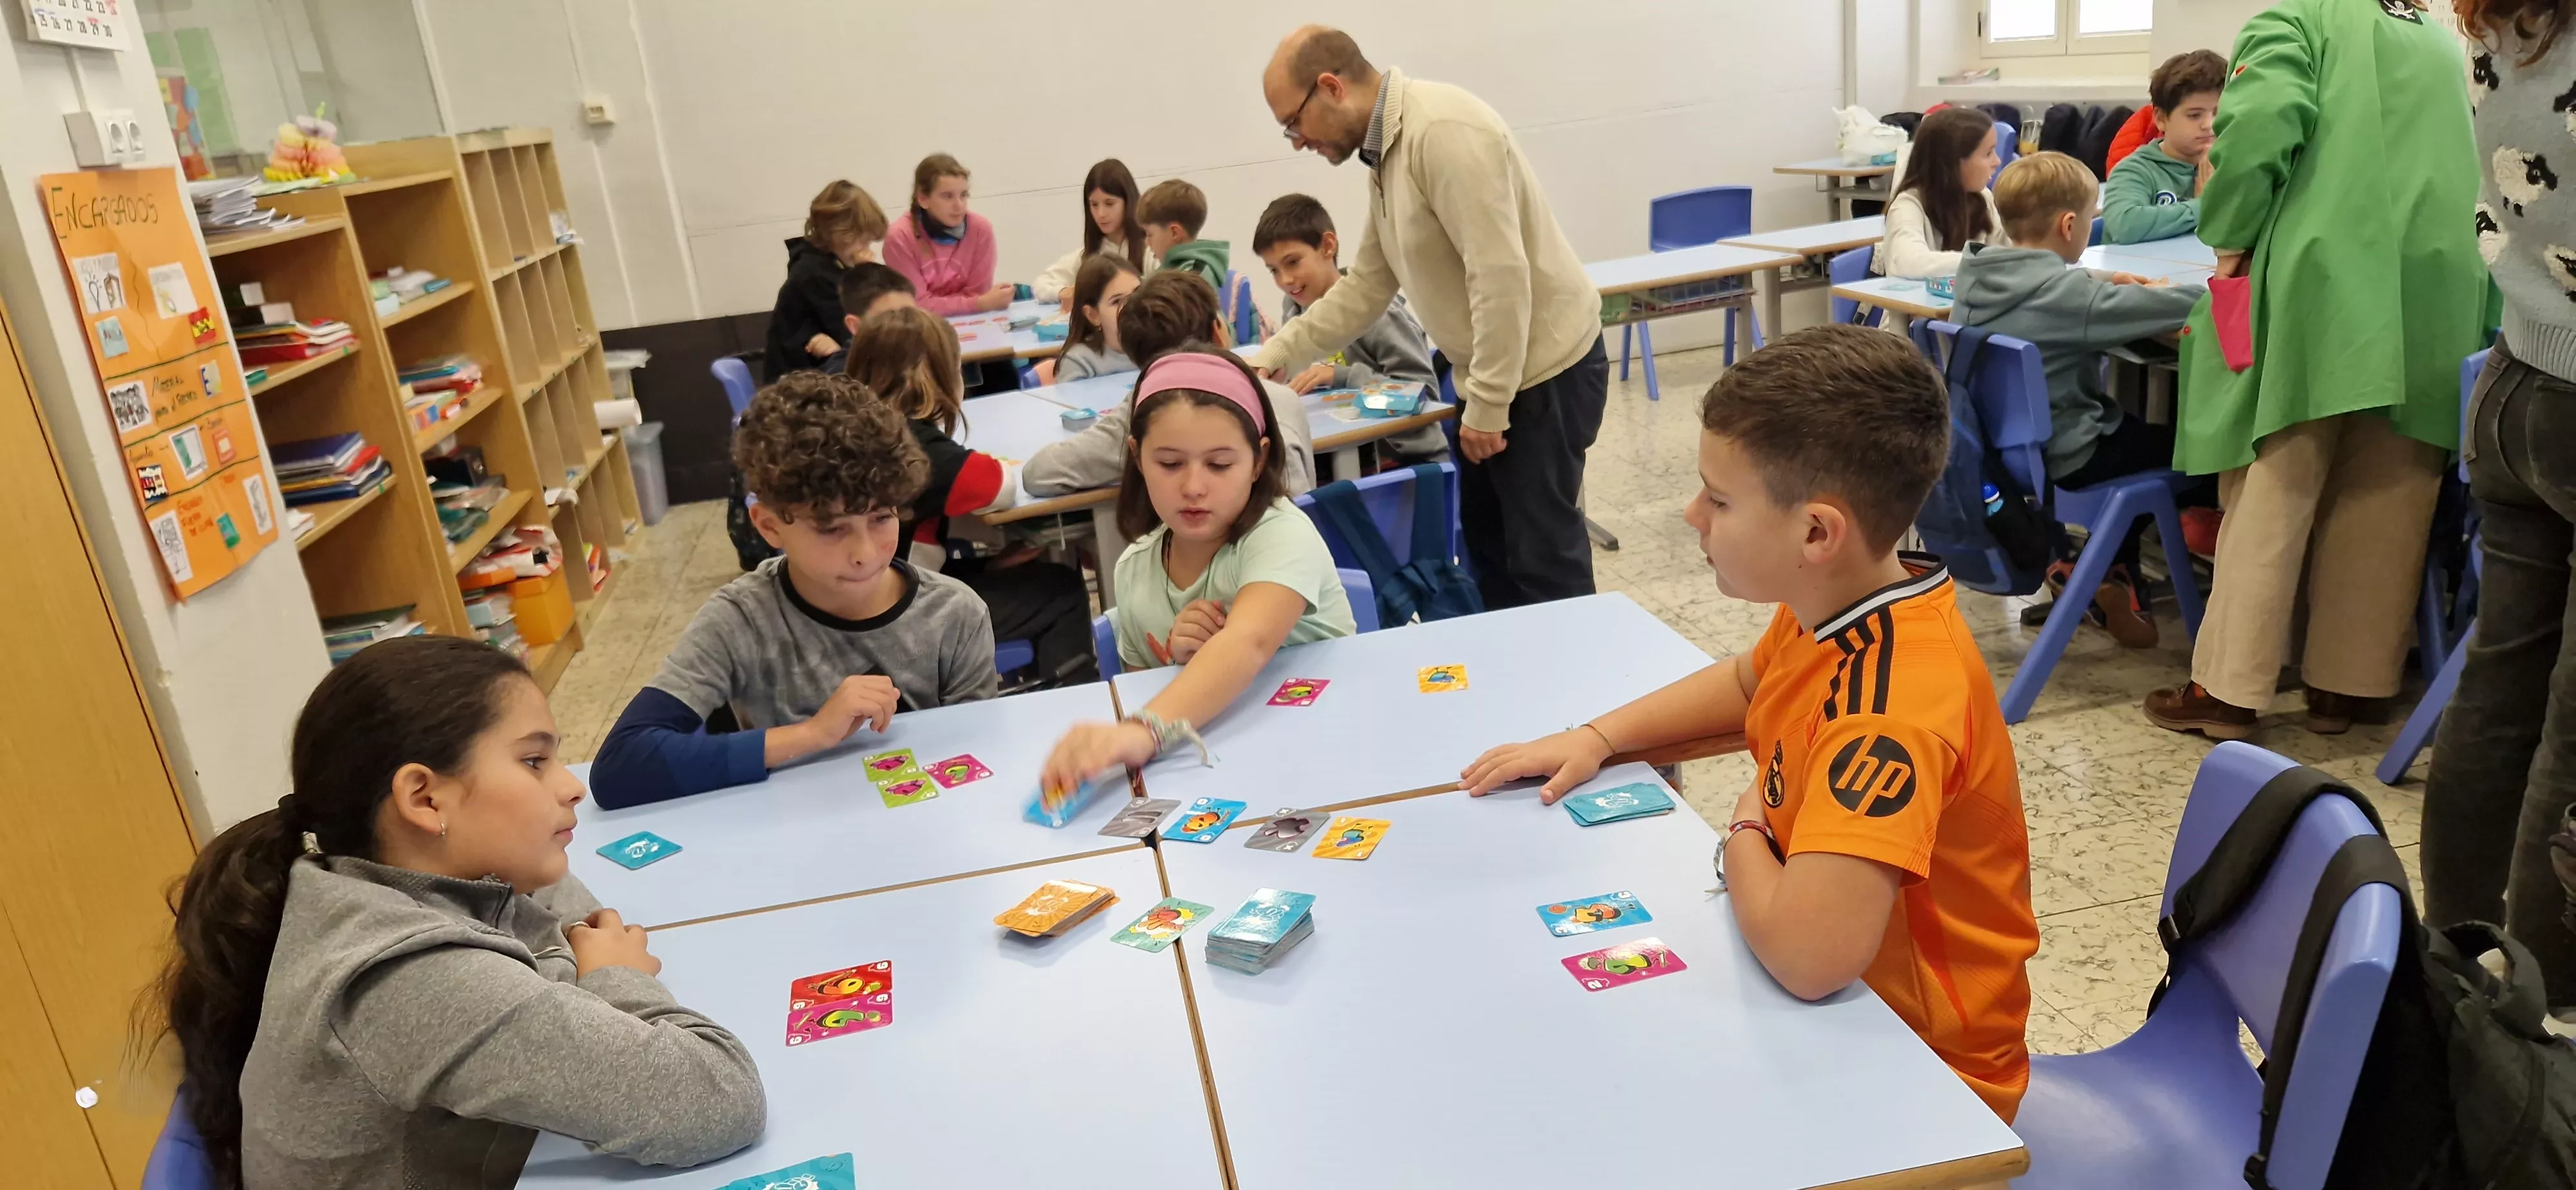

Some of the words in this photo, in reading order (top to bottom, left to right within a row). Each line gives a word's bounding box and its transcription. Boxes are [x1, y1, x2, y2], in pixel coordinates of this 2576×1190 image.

[51, 186, 158, 239] ENCARGADOS
[1834, 733, 1911, 817] hp
[1587, 979, 1604, 989] 2
